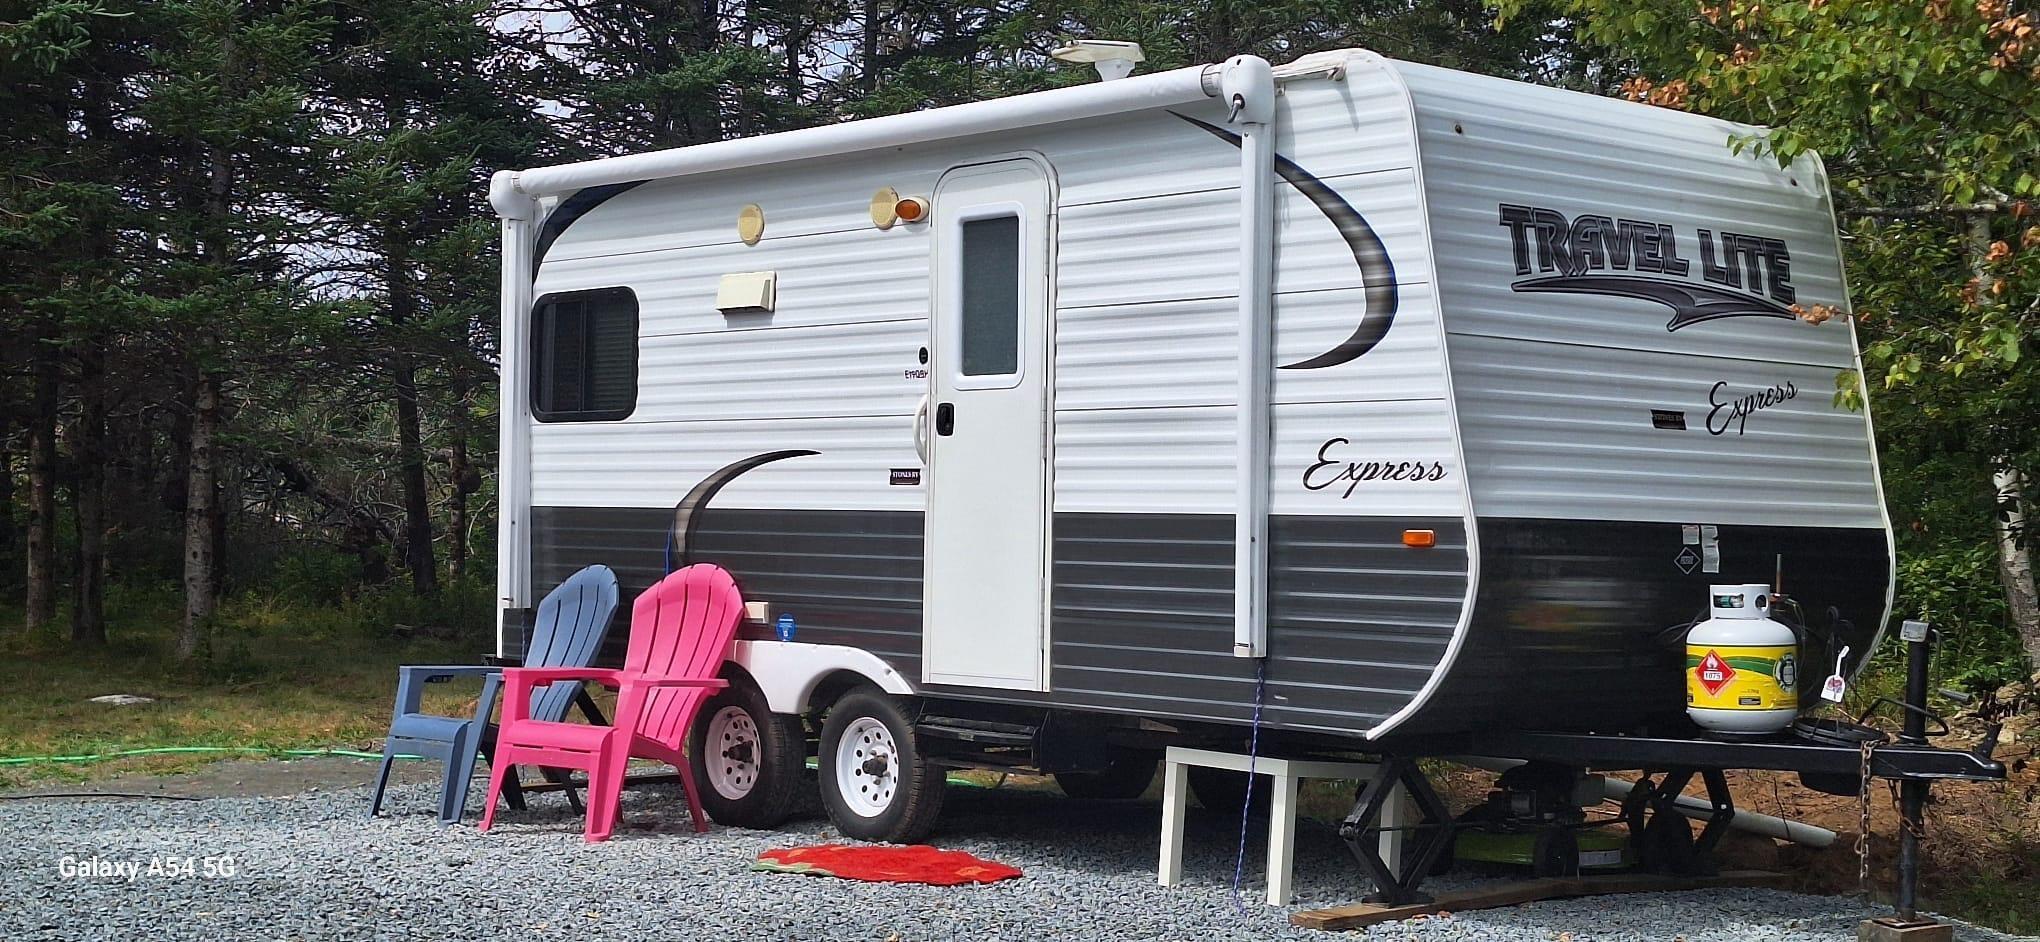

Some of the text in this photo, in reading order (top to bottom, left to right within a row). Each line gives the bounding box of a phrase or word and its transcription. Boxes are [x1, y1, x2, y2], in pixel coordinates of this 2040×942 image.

[1499, 203, 1796, 303] TRAVEL LITE
[1705, 381, 1798, 435] Express
[1303, 437, 1448, 499] Express
